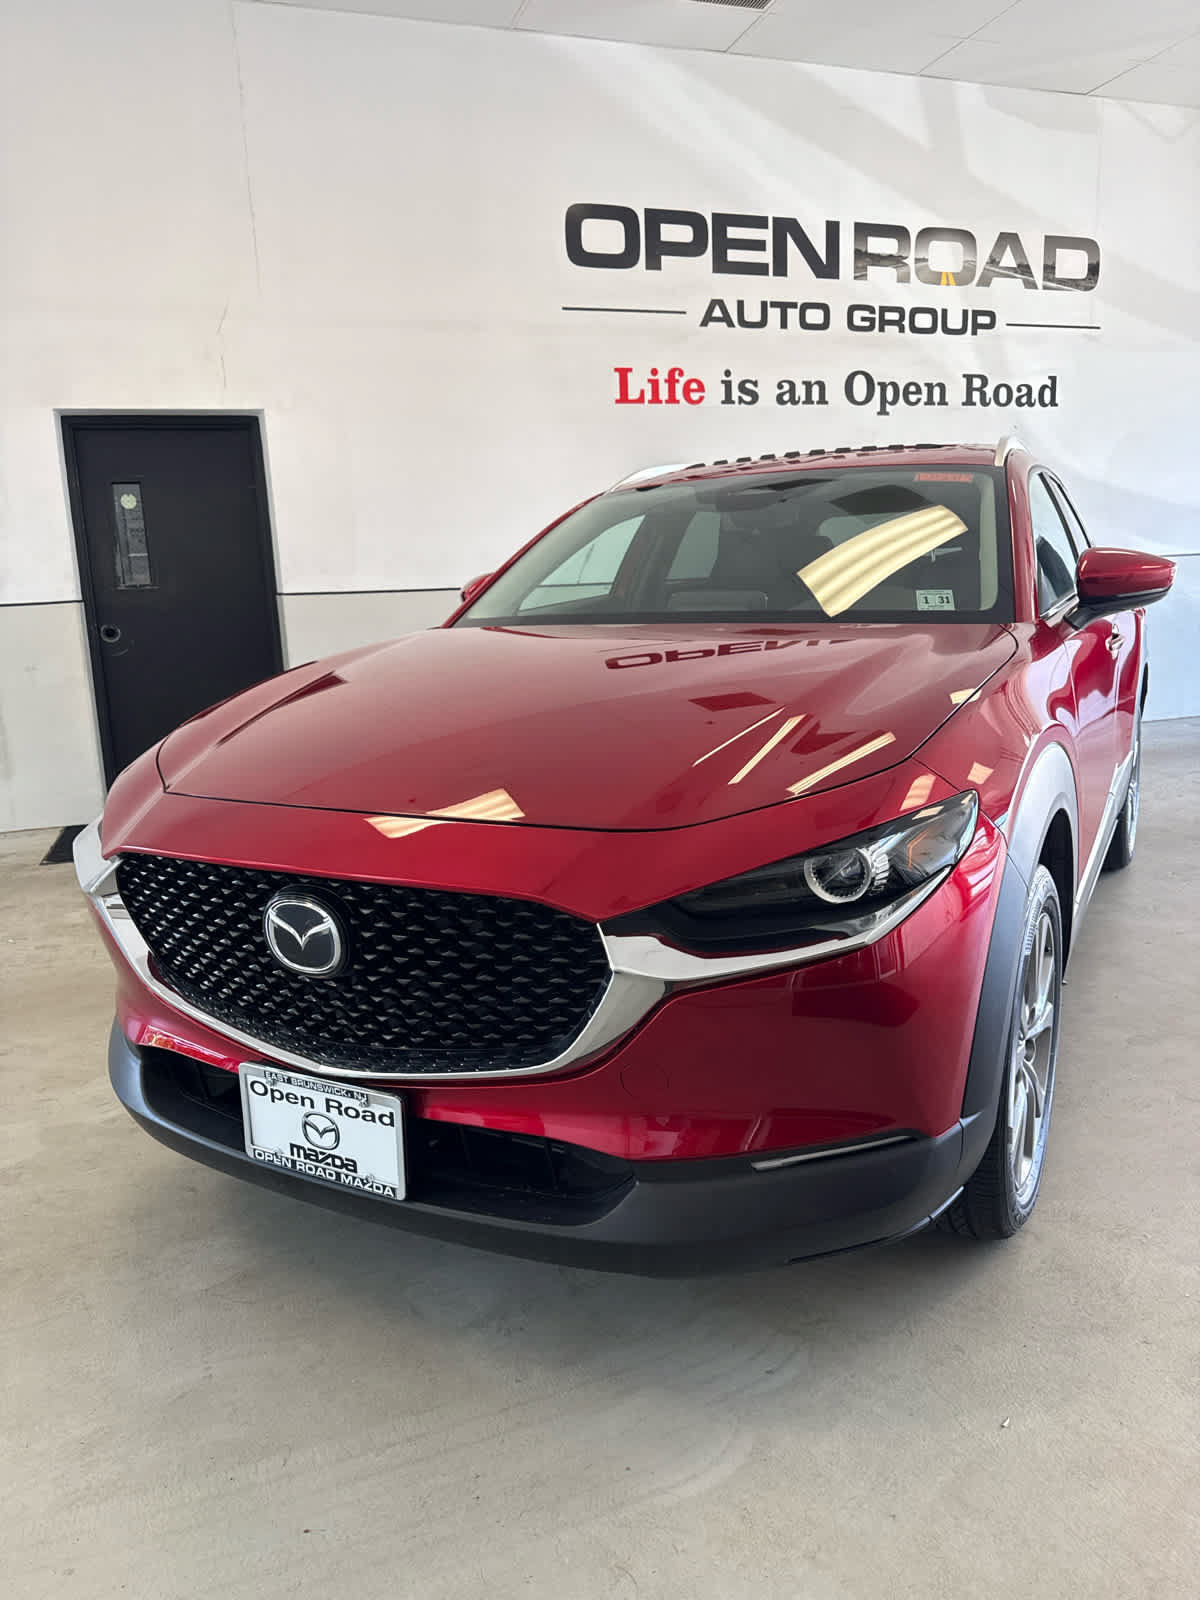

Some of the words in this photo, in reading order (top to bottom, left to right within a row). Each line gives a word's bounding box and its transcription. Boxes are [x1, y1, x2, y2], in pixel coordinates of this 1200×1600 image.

[565, 203, 840, 280] OPEN
[854, 222, 1100, 291] ROAD
[700, 299, 830, 330] AUTO
[847, 304, 996, 335] GROUP
[614, 368, 705, 405] Life
[721, 369, 759, 405] is
[776, 380, 828, 405] an
[845, 371, 948, 415] Open
[962, 374, 1058, 407] Road
[265, 1071, 288, 1082] EAST
[250, 1080, 315, 1109] Open
[325, 1098, 395, 1127] Road
[255, 1150, 291, 1168] OPEN
[296, 1162, 336, 1180] ROAD
[341, 1174, 394, 1197] MAZDA
